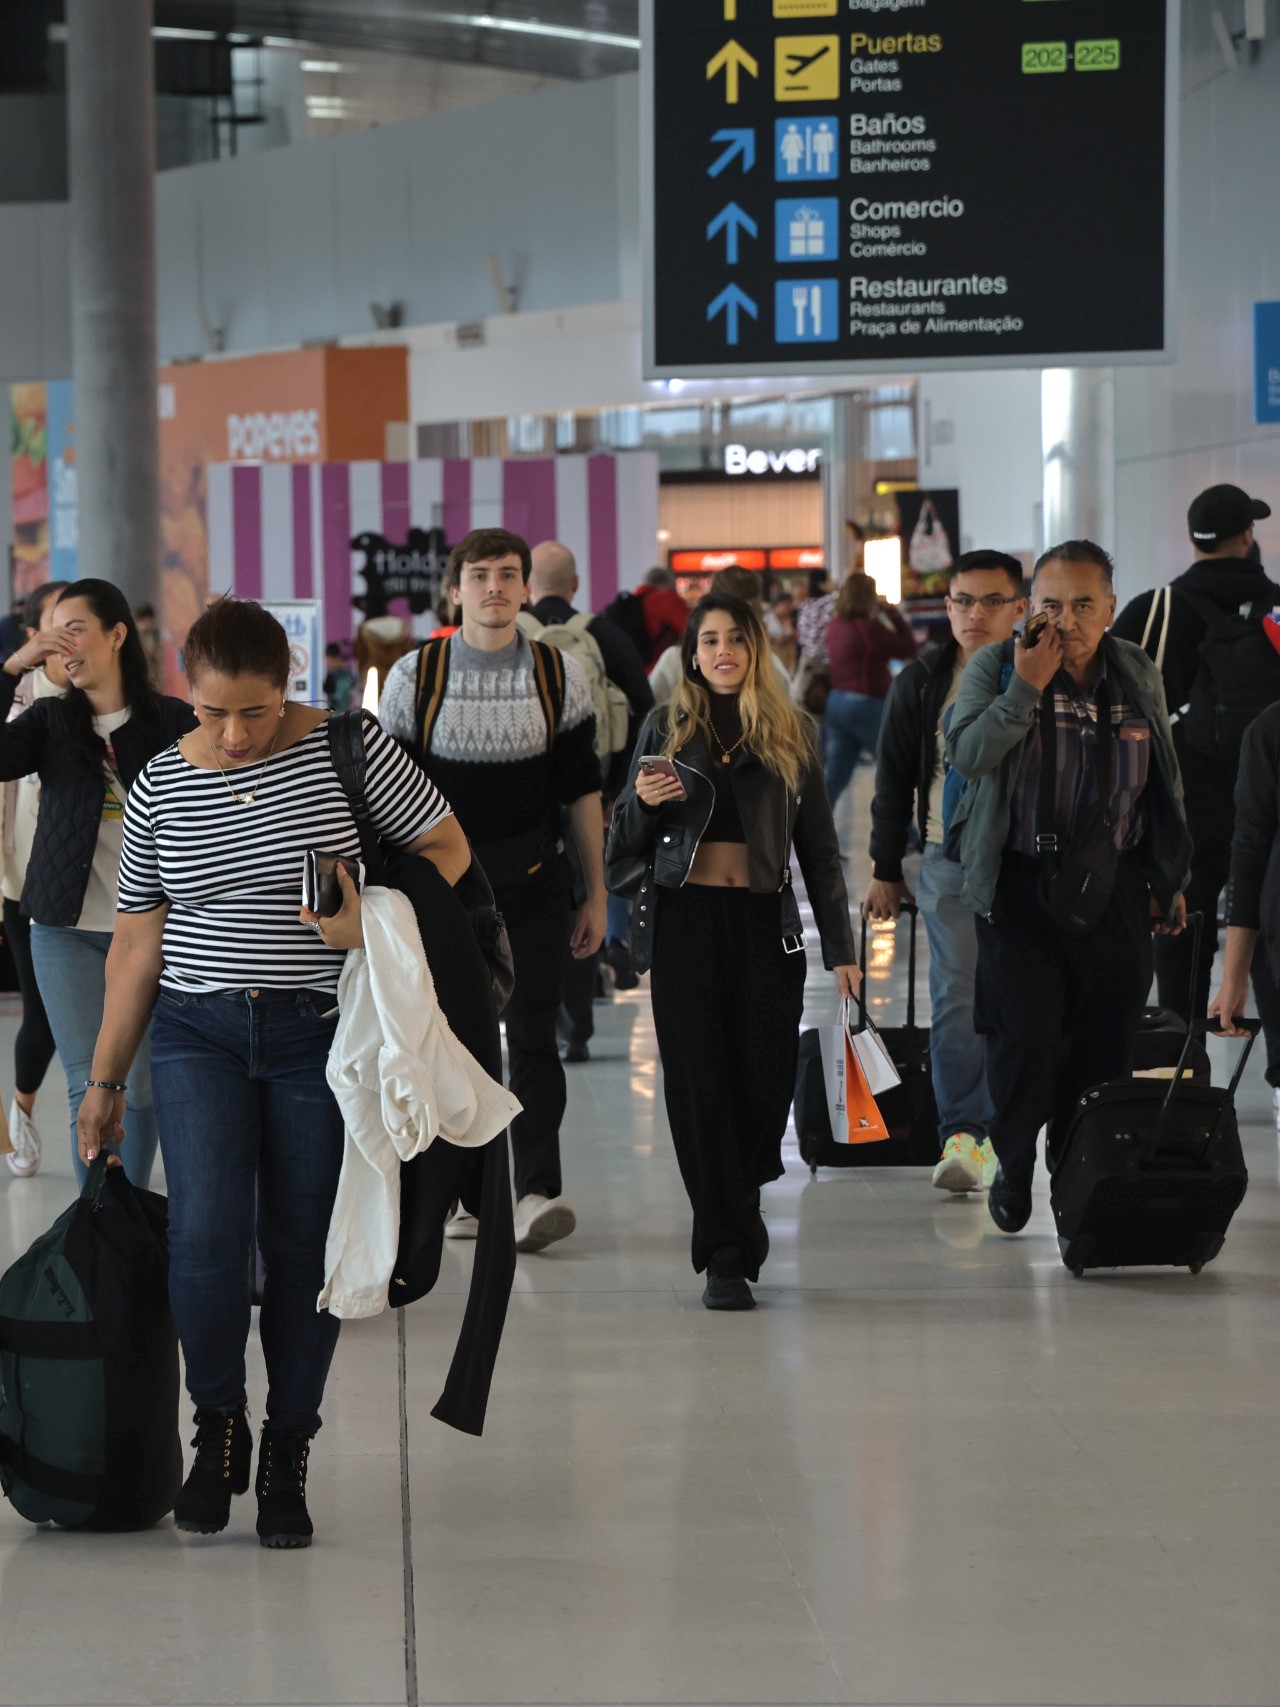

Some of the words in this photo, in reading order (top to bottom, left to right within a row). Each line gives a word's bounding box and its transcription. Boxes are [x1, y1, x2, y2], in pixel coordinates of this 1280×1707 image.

[850, 32, 943, 55] Puertas
[850, 57, 899, 74] Gates
[850, 76, 903, 93] Portas
[850, 112, 926, 136] Baños
[850, 138, 937, 155] Bathrooms
[850, 156, 931, 173] Banheiros
[850, 195, 964, 221] Comercio
[850, 222, 902, 241] Shops
[850, 274, 1008, 299] Restaurantes
[850, 301, 946, 317] Restaurants
[850, 319, 897, 338] Praça
[899, 319, 921, 334] de
[924, 315, 1024, 335] Alimentação
